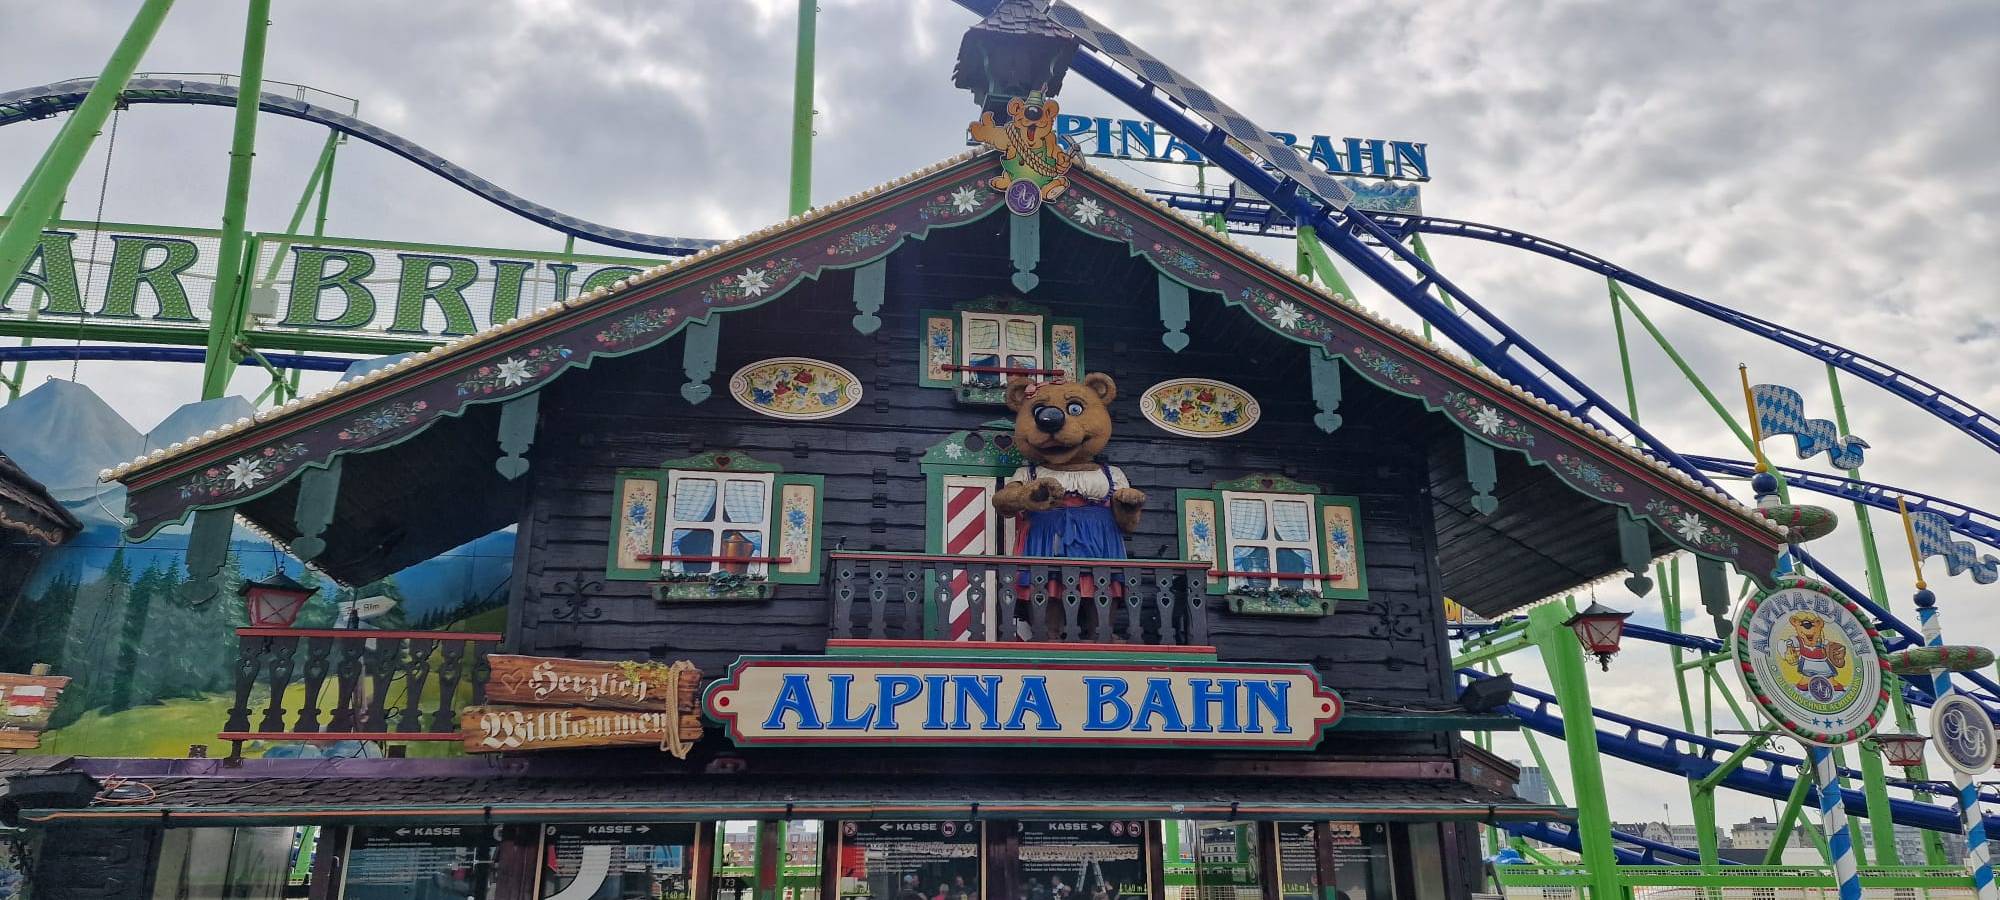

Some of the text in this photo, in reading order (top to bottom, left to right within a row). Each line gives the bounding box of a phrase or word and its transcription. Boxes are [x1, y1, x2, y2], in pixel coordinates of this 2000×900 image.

[528, 661, 648, 703] Herzlich
[761, 673, 1294, 736] ALPINA BAHN
[480, 709, 667, 749] Willkommen
[414, 827, 461, 836] KASSE
[588, 825, 633, 834] KASSE
[896, 823, 937, 831] KASSE
[1049, 823, 1088, 831] KASSE
